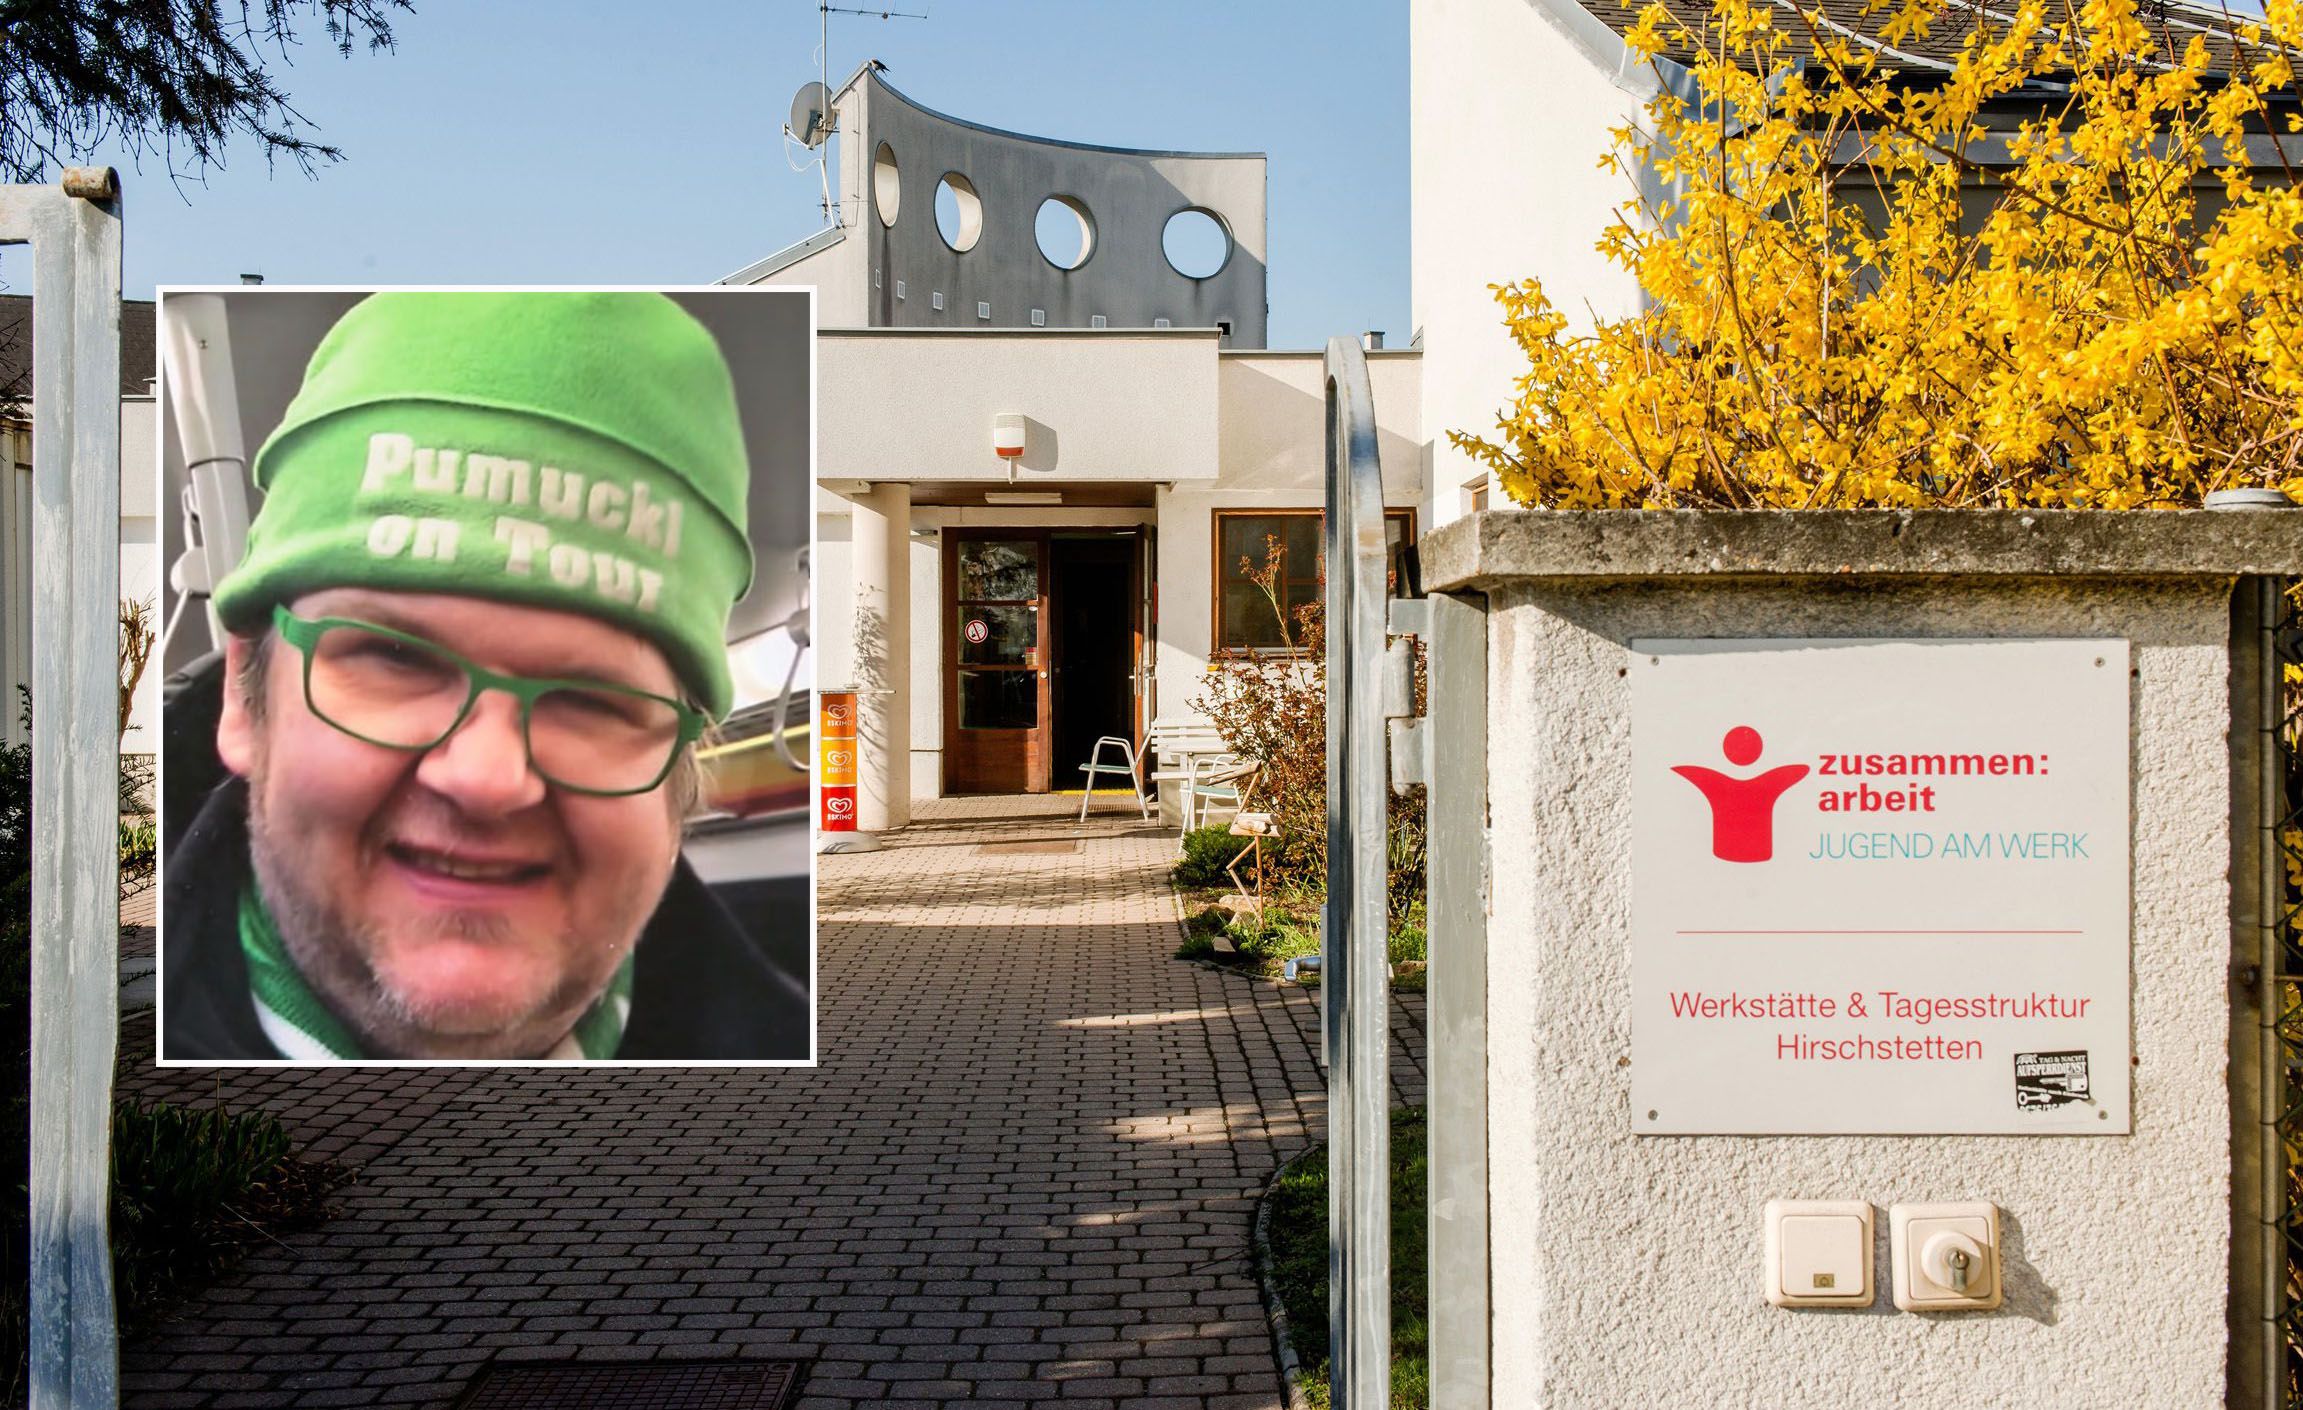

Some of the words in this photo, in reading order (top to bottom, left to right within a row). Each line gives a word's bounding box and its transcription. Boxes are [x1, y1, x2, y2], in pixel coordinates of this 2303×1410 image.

[361, 432, 683, 560] Pumuckl
[367, 514, 460, 563] on
[494, 516, 664, 612] Tour
[1818, 753, 2049, 776] zusammen:
[1818, 783, 1936, 812] arbeit
[827, 813, 853, 821] ESKIMO
[1809, 832, 1933, 859] JUGEND
[1941, 832, 1991, 859] AM
[1999, 832, 2089, 859] WERK
[1670, 991, 1837, 1019] Werkstätte
[1847, 991, 1868, 1018] &
[1878, 991, 2090, 1025] Tagesstruktur
[1777, 1034, 1983, 1061] Hirschstetten
[2061, 1055, 2087, 1063] NACHT
[2016, 1062, 2087, 1077] AUFSPERRDIENST
